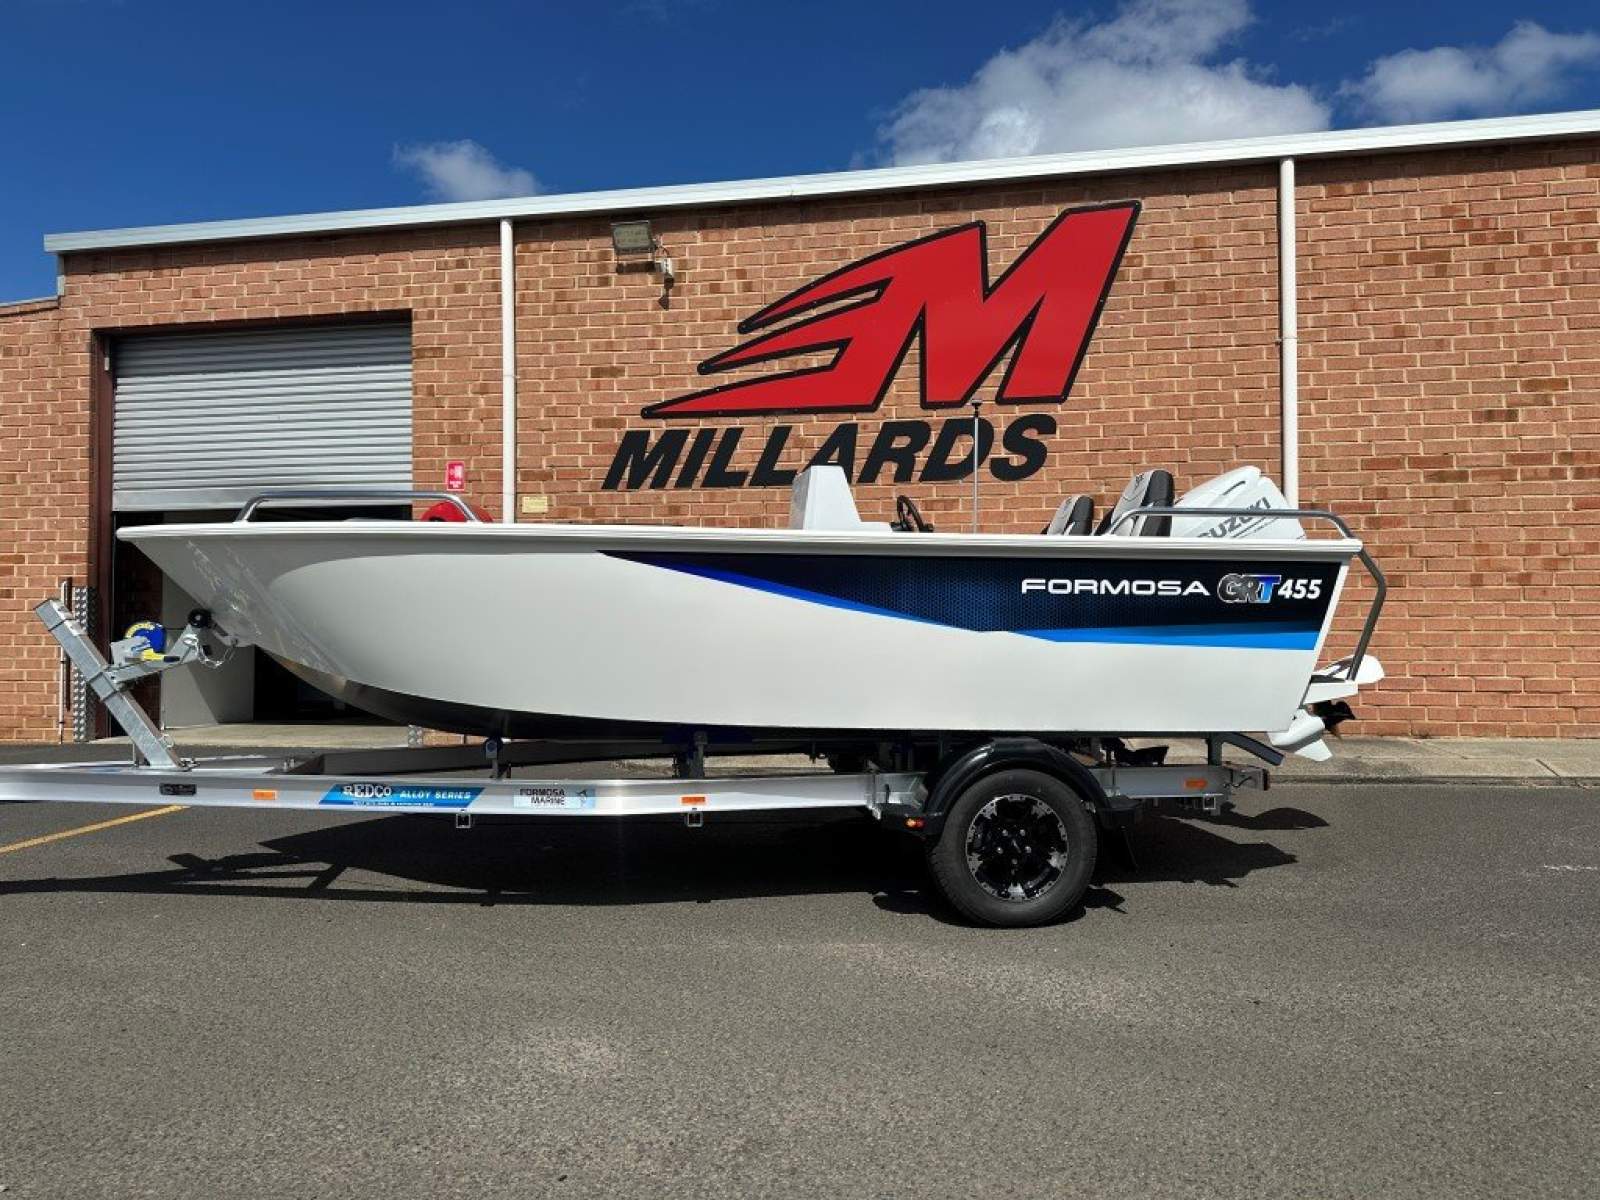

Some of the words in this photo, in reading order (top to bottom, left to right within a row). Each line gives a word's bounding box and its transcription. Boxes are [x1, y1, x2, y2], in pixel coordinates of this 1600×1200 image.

[601, 413, 1057, 490] MILLARDS
[1021, 578, 1210, 596] FORMOSA
[1216, 573, 1282, 604] GRT
[1277, 578, 1323, 600] 455
[341, 783, 393, 799] REDCO
[399, 790, 431, 800] ALLOY
[434, 791, 472, 801] SERIES
[519, 788, 566, 798] FORMOSA
